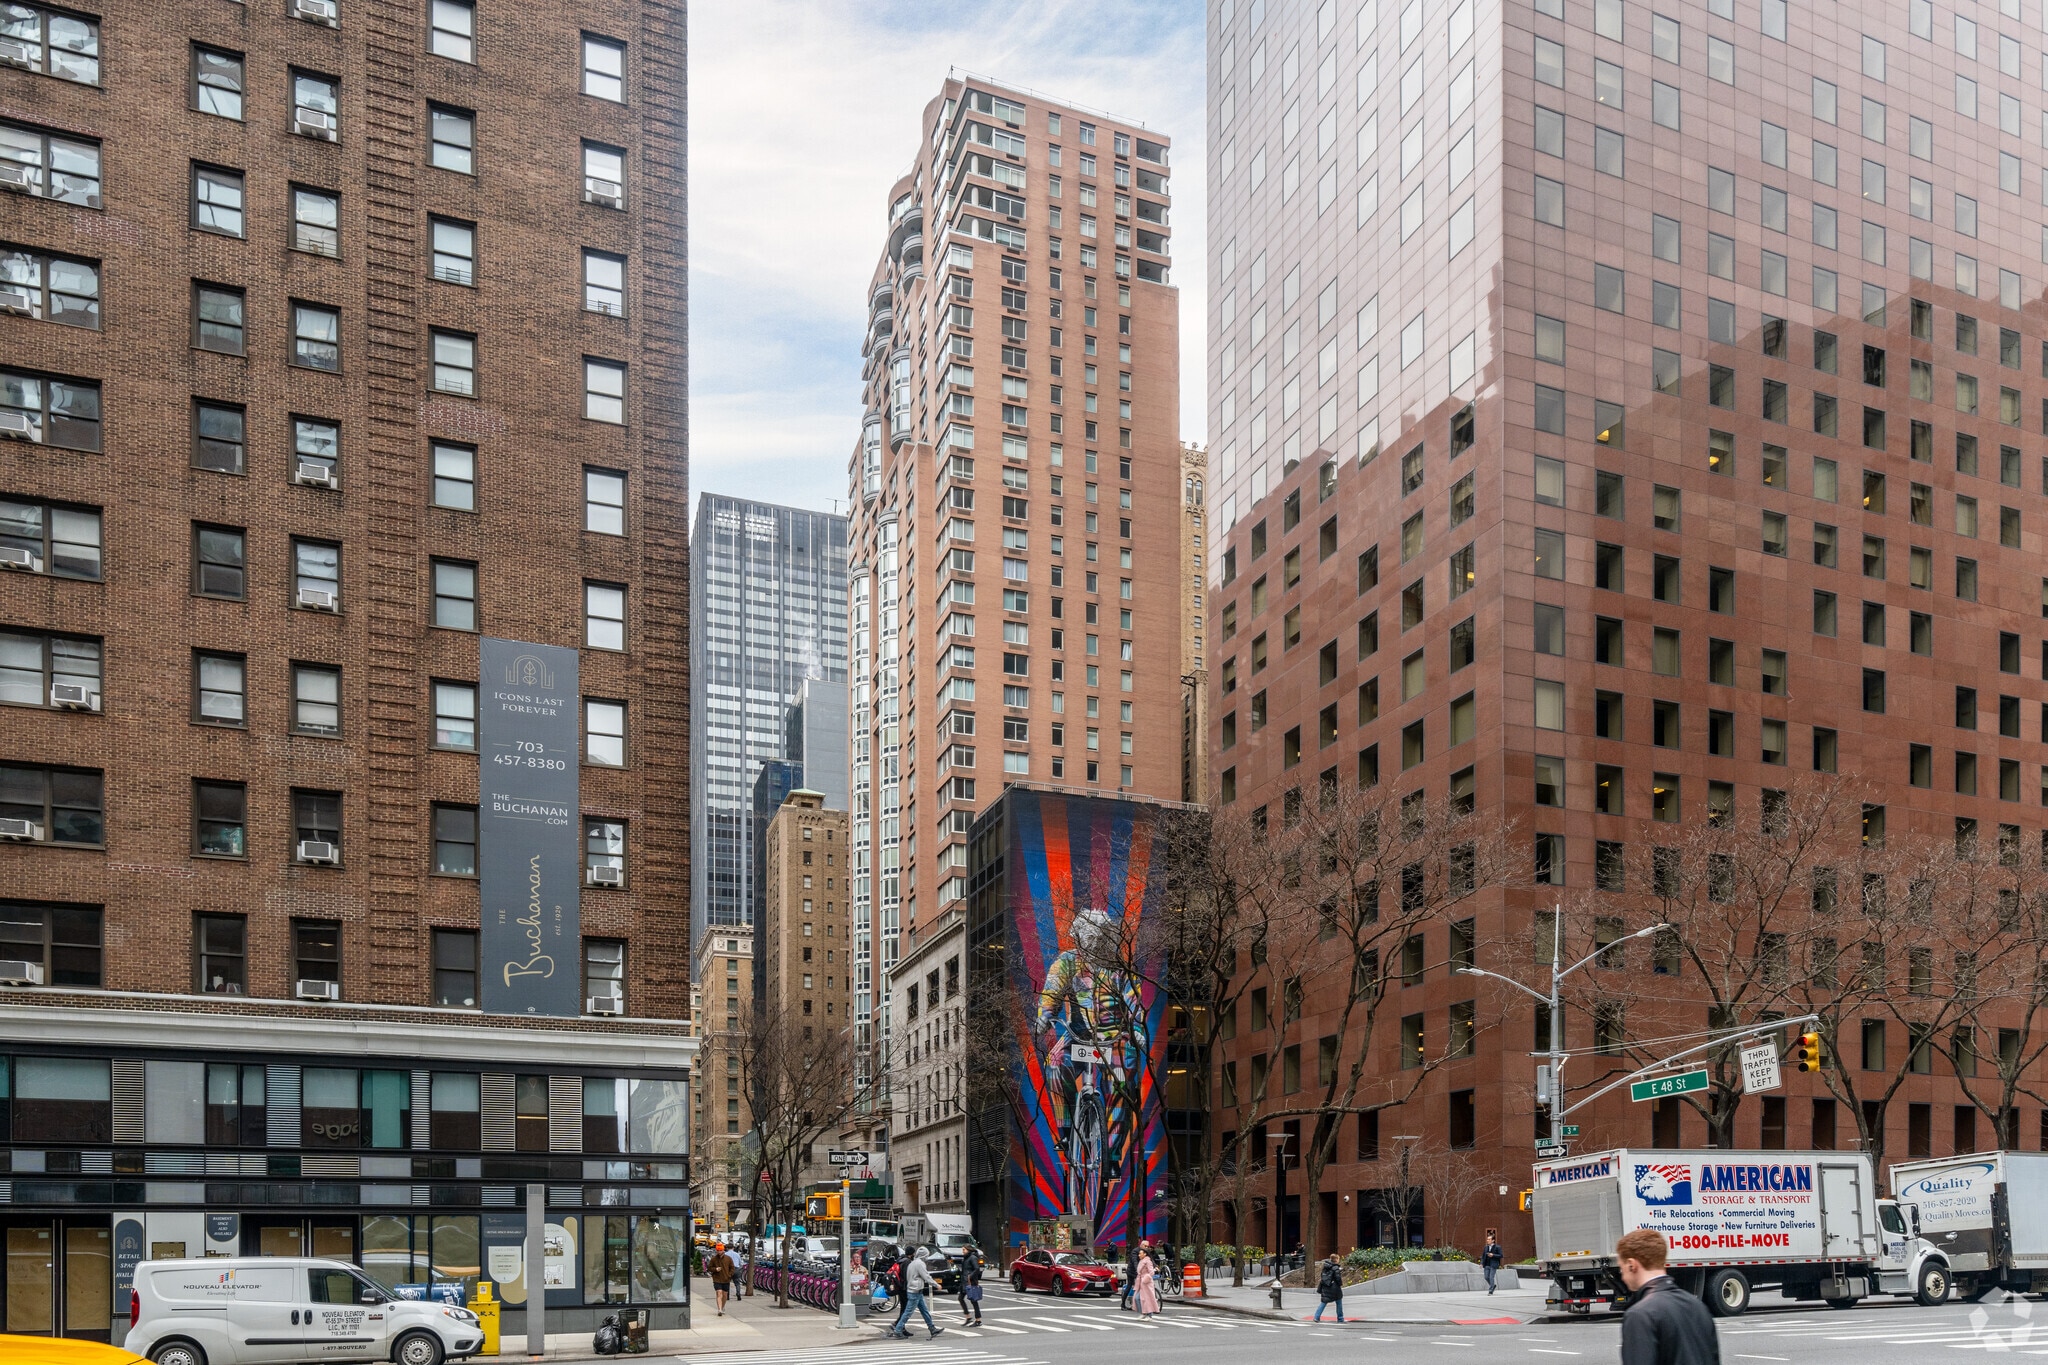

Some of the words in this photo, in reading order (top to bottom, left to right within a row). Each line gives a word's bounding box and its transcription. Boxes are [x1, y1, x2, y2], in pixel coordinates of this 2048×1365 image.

[494, 692, 531, 703] ICONS
[536, 697, 565, 707] LAST
[502, 704, 557, 716] FOREVER
[516, 741, 544, 753] 703
[494, 754, 566, 770] 457-8380
[492, 793, 510, 801] THE
[493, 802, 568, 817] BUCHANAN
[503, 854, 554, 988] Buchanan
[1747, 1049, 1769, 1060] THRU
[1743, 1057, 1776, 1070] TRAFFIC
[1750, 1068, 1772, 1078] KEEP
[1651, 1084, 1657, 1094] E
[1661, 1080, 1673, 1092] 48
[1676, 1078, 1686, 1090] St
[1751, 1077, 1772, 1088] LEFT
[1567, 1127, 1572, 1135] 3
[1549, 1162, 1610, 1184] AMERICAN
[1699, 1164, 1813, 1192] AMERICAN
[1920, 1178, 1973, 1194] Quality
[1702, 1195, 1744, 1204] STORAGE
[1748, 1195, 1756, 1204] &
[1760, 1195, 1811, 1204] TRANSPORT
[1922, 1197, 1977, 1209] 516-827-2020
[1653, 1209, 1667, 1218] File
[1670, 1209, 1714, 1218] Relocations
[1722, 1208, 1765, 1217] Commercial
[1768, 1208, 1795, 1218] Moving
[1919, 1209, 1990, 1222] .QualityMoves.co
[1640, 1222, 1685, 1231] Warehouse
[1688, 1222, 1719, 1232] Storage
[1725, 1222, 1742, 1230] New
[1745, 1221, 1777, 1230] Furniture
[1780, 1220, 1816, 1230] Deliveries
[1669, 1233, 1790, 1249] 1-800-FILE-MOVE
